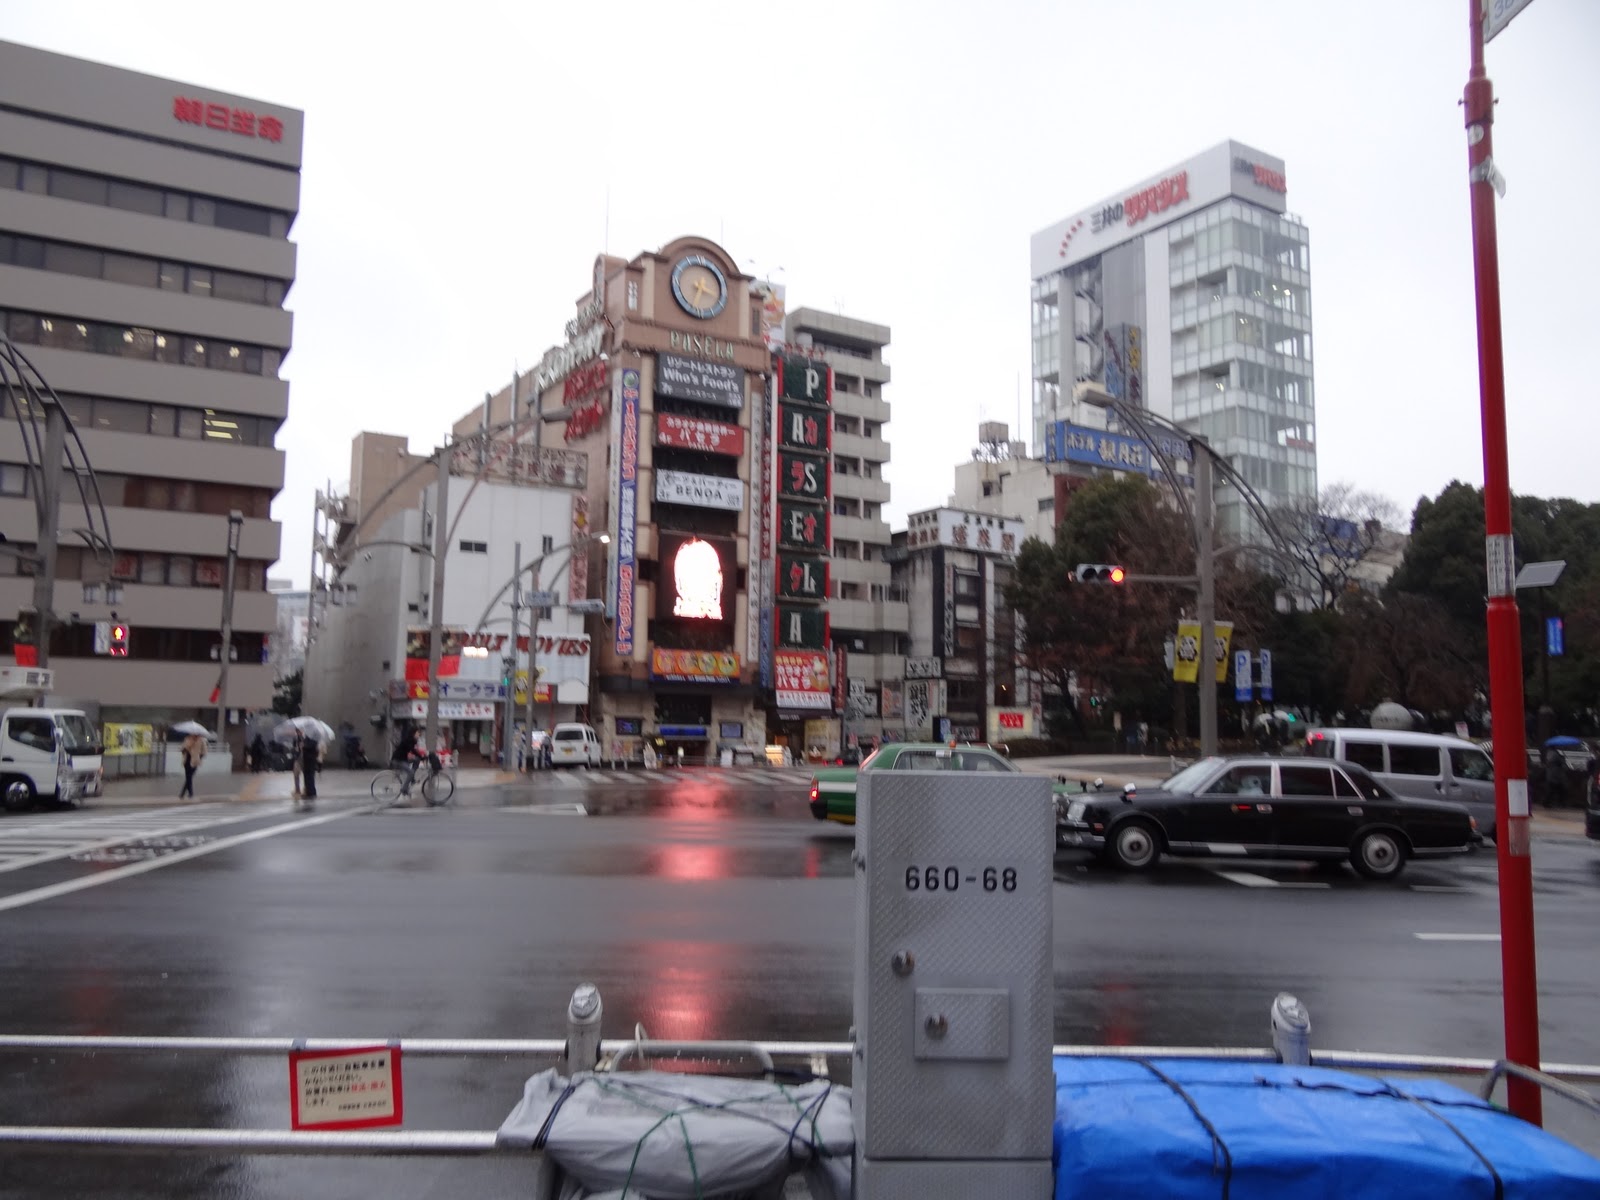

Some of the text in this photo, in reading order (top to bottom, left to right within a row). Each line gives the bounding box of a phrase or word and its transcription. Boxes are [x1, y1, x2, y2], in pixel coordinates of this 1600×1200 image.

[173, 96, 283, 144] 朝日生命
[671, 330, 734, 359] PASELA
[675, 484, 723, 500] BENOA
[905, 866, 1018, 891] 660-68
